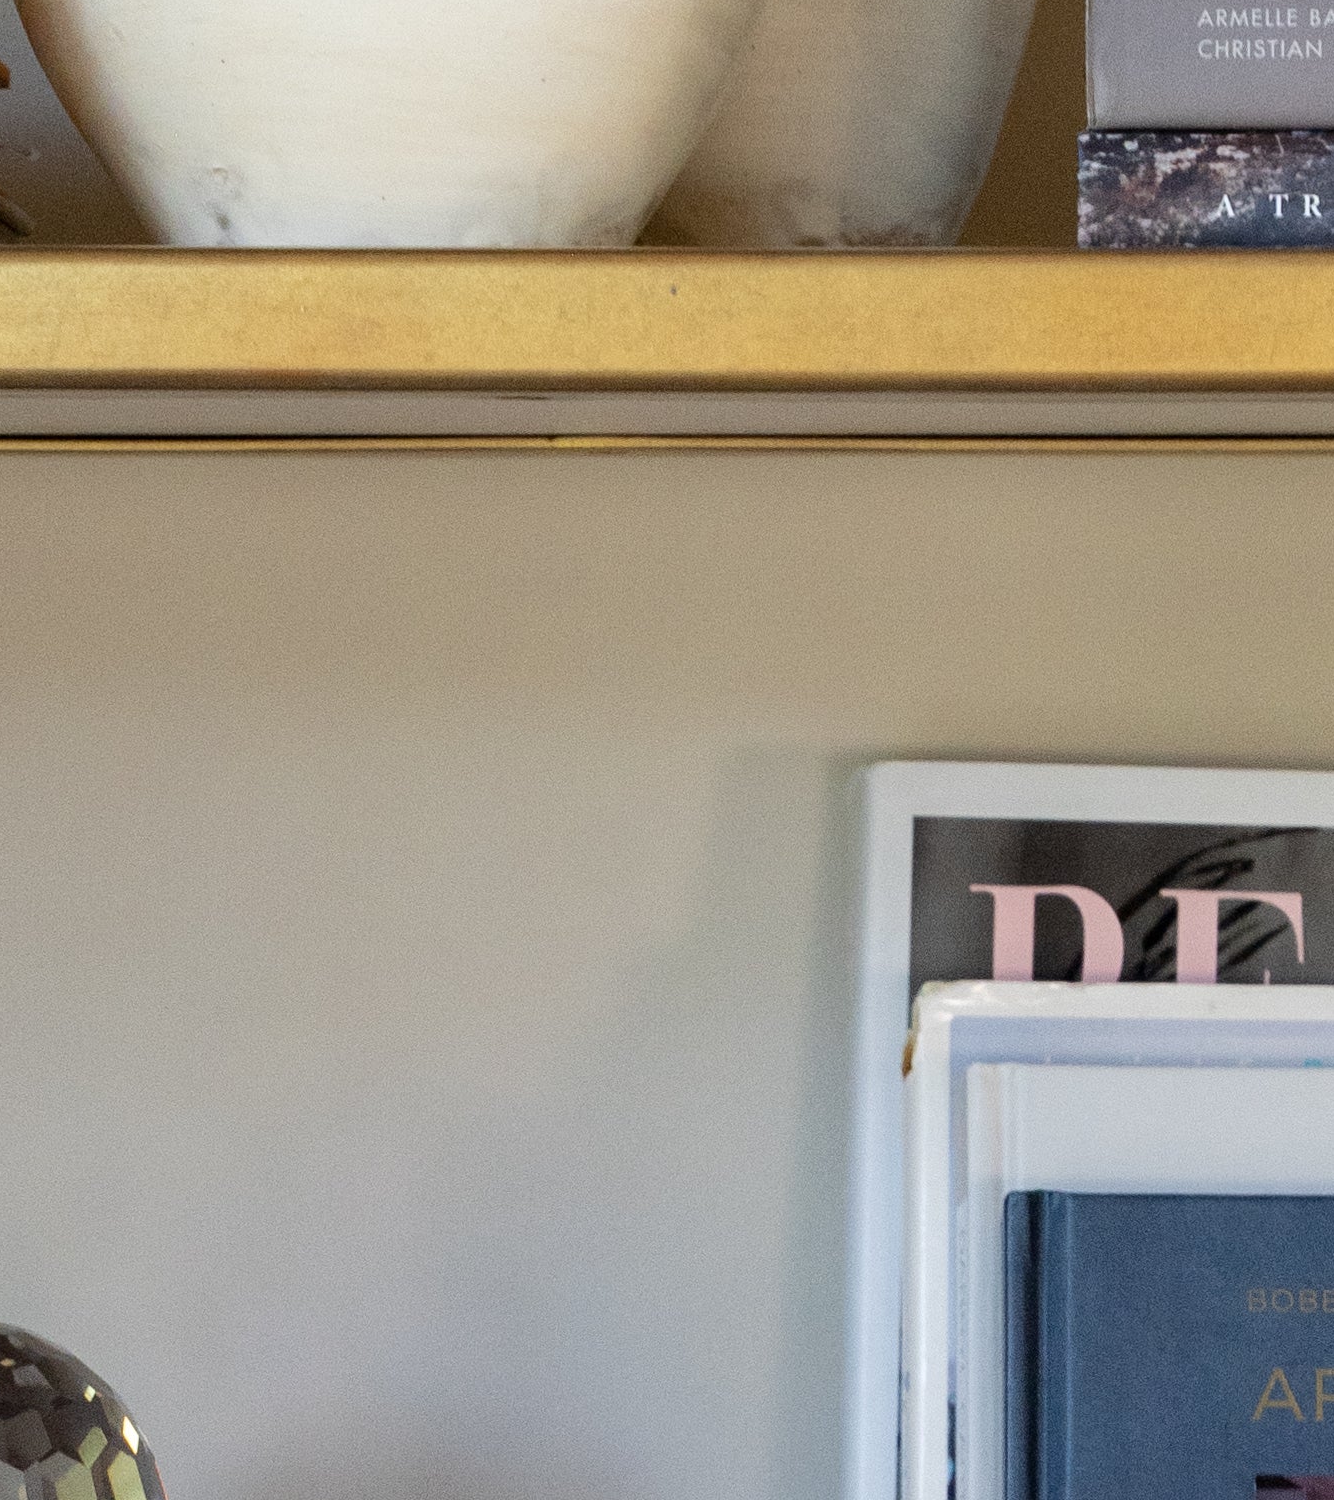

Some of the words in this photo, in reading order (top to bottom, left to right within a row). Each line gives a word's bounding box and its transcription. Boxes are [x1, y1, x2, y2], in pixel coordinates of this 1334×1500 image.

[1197, 8, 1299, 28] ARMELLE
[1197, 38, 1322, 61] CHRISTIAN
[1216, 194, 1237, 218] A
